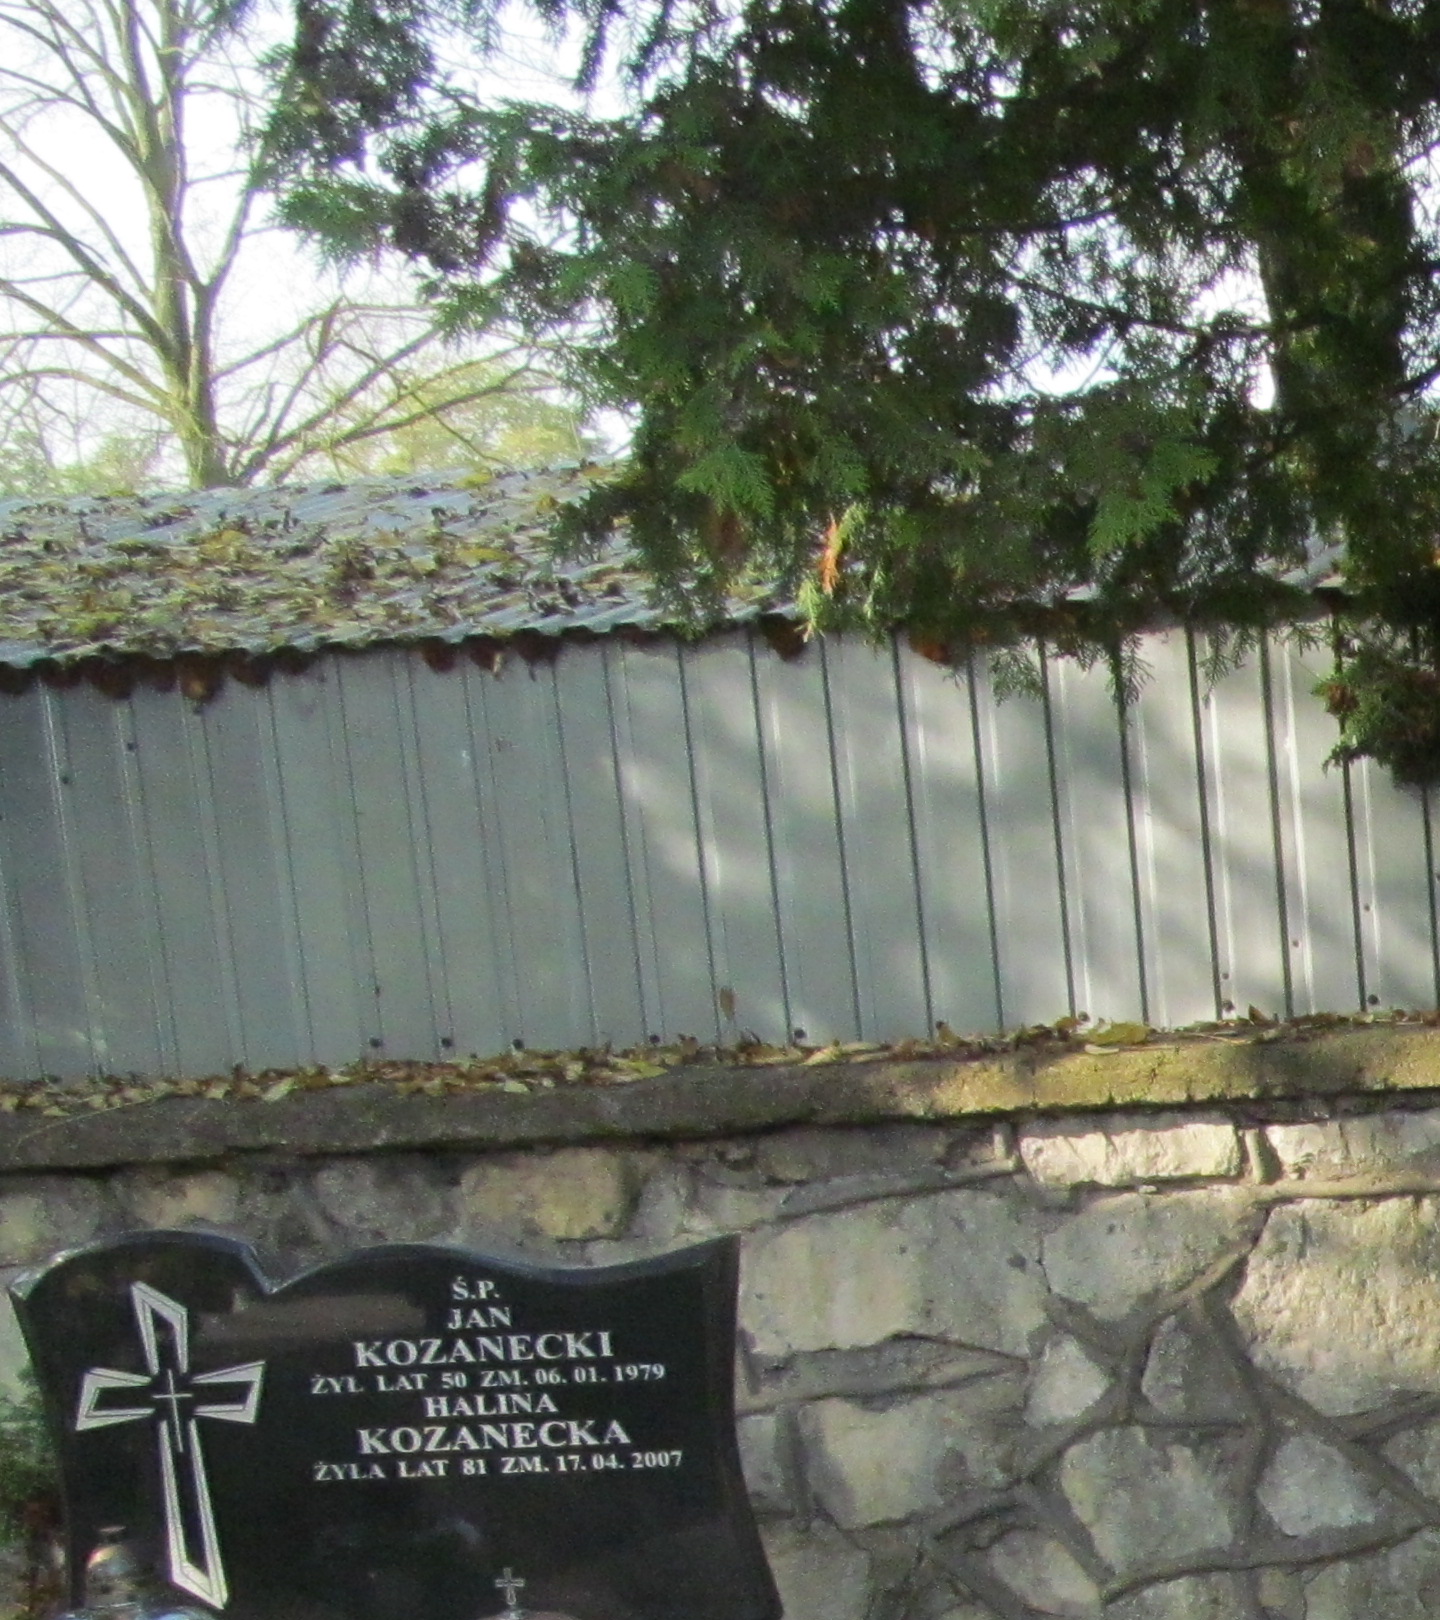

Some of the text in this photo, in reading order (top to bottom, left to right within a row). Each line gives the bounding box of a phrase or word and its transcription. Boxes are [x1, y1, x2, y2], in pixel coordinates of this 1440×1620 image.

[452, 1276, 500, 1300] Ś.P.
[447, 1306, 512, 1330] JAN
[353, 1331, 615, 1368] KOZANECKI
[376, 1373, 428, 1392] LAT
[441, 1371, 468, 1389] 50
[481, 1368, 529, 1388] ZM.
[534, 1367, 567, 1385] 06.
[573, 1365, 608, 1383] 01.
[614, 1363, 666, 1383] 1979
[424, 1393, 559, 1418] HALINA
[357, 1418, 632, 1455] KOZANECKA
[398, 1459, 449, 1479] LAT
[462, 1457, 488, 1476] 81
[500, 1455, 550, 1475] ZM.
[557, 1454, 587, 1472] 17.
[591, 1452, 625, 1470] 04.
[631, 1450, 682, 1469] 2007
